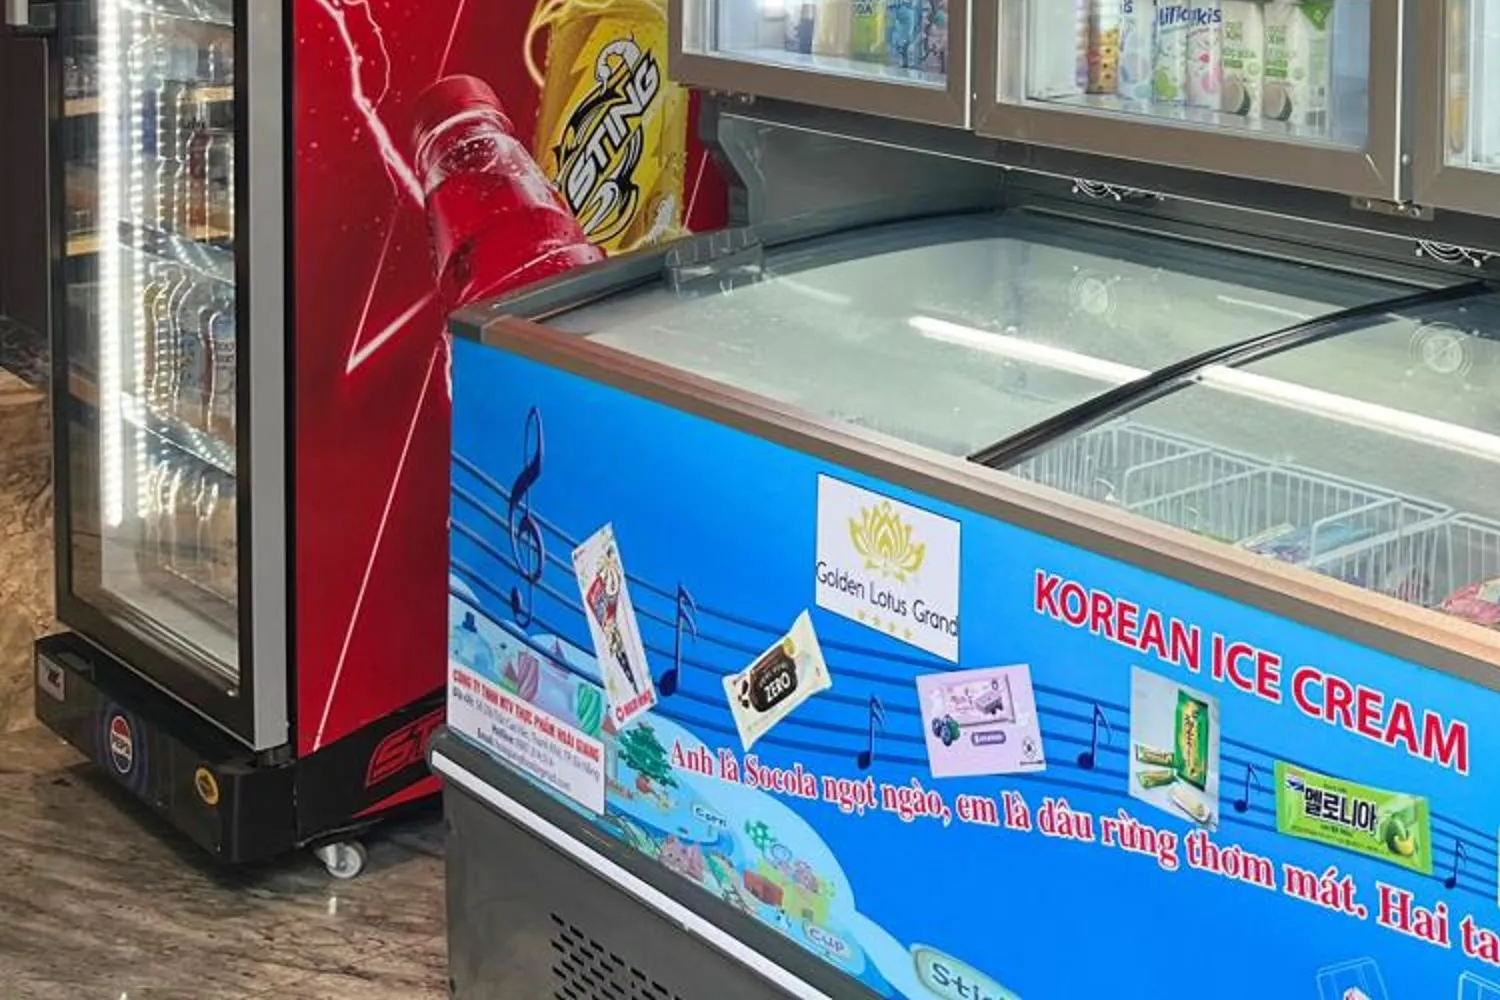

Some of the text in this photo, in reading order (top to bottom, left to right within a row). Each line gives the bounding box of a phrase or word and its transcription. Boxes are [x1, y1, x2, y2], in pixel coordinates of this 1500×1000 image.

[565, 52, 661, 215] STING
[815, 560, 960, 638] Golden Lotus Grand
[1034, 569, 1469, 776] KOREAN ICE CREAM
[671, 739, 714, 778] Anh
[718, 747, 740, 783] là
[744, 754, 819, 801] Socola
[823, 776, 877, 817] ngọt
[880, 778, 951, 827] ngào,
[957, 798, 999, 828] em
[1004, 788, 1033, 832] là
[1038, 797, 1095, 843] dâu
[1101, 807, 1180, 872] rừng
[1185, 830, 1275, 891] thơm
[1283, 864, 1368, 921] mát.
[1375, 880, 1452, 948] Hai
